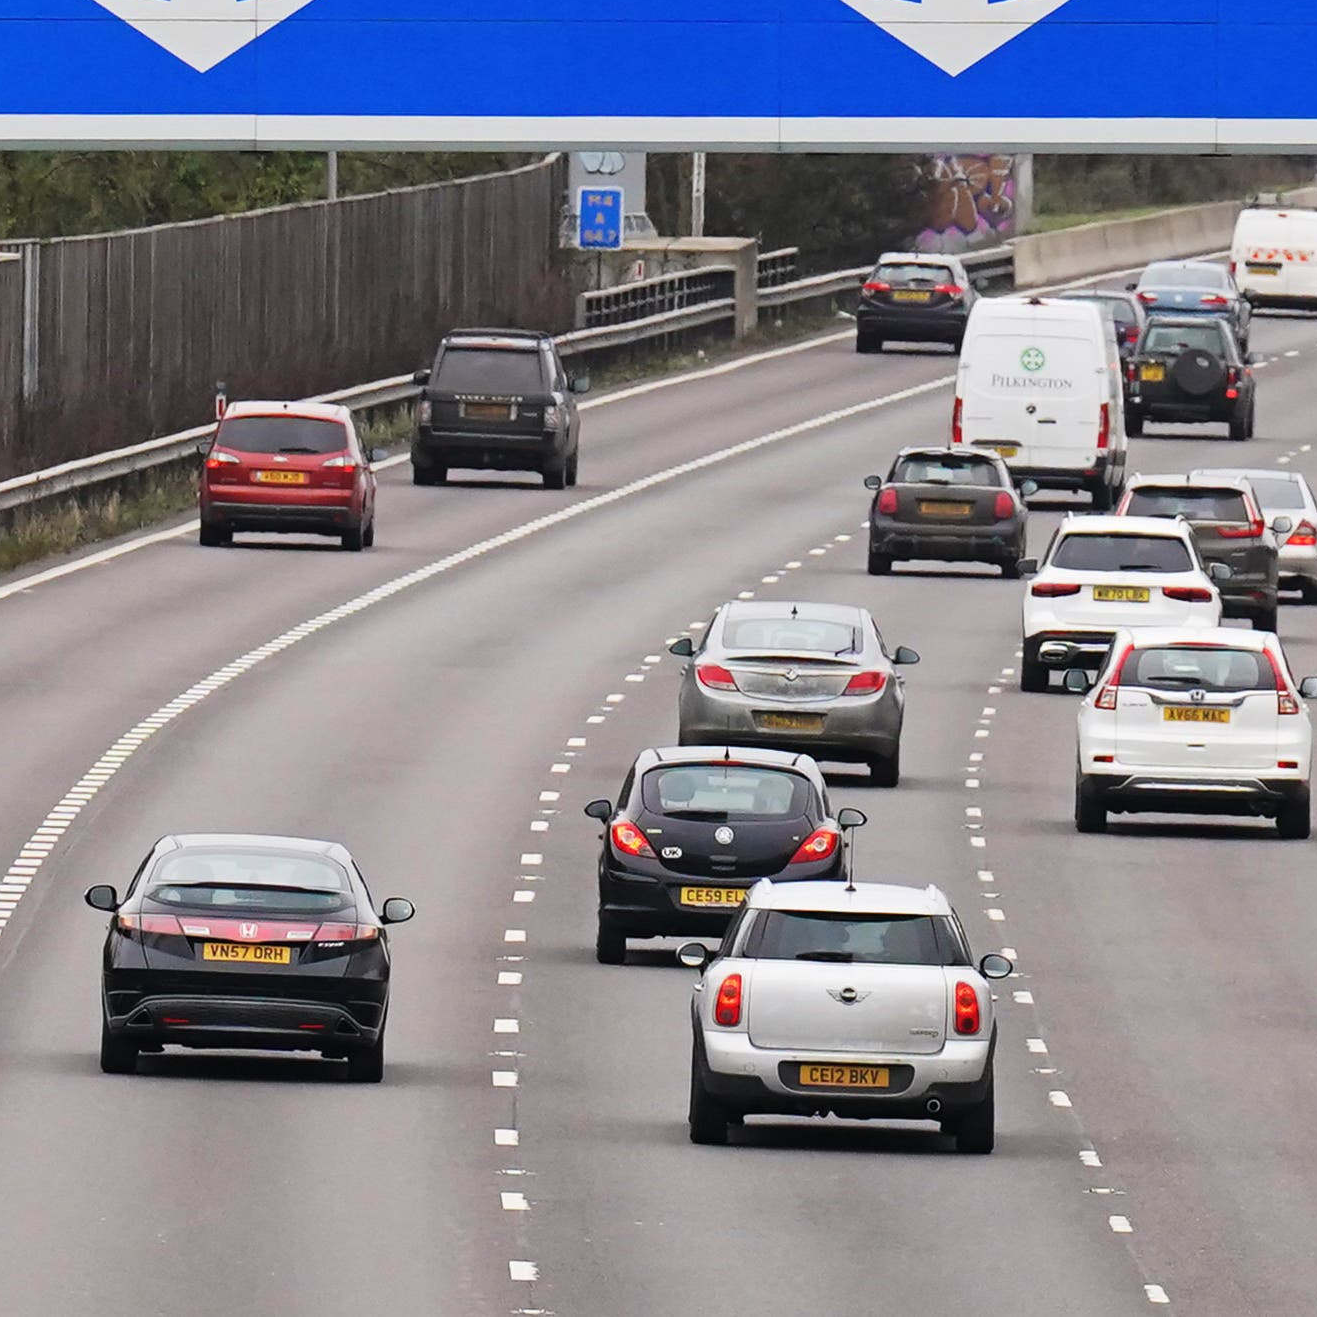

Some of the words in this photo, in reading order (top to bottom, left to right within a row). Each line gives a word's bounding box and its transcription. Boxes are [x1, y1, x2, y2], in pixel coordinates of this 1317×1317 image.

[991, 374, 1073, 389] PILKINGTON
[663, 848, 680, 857] UK
[686, 889, 722, 903] CE59
[725, 890, 745, 903] EL
[210, 944, 250, 959] VN57
[809, 1067, 845, 1083] CE12
[848, 1069, 880, 1085] BKV
